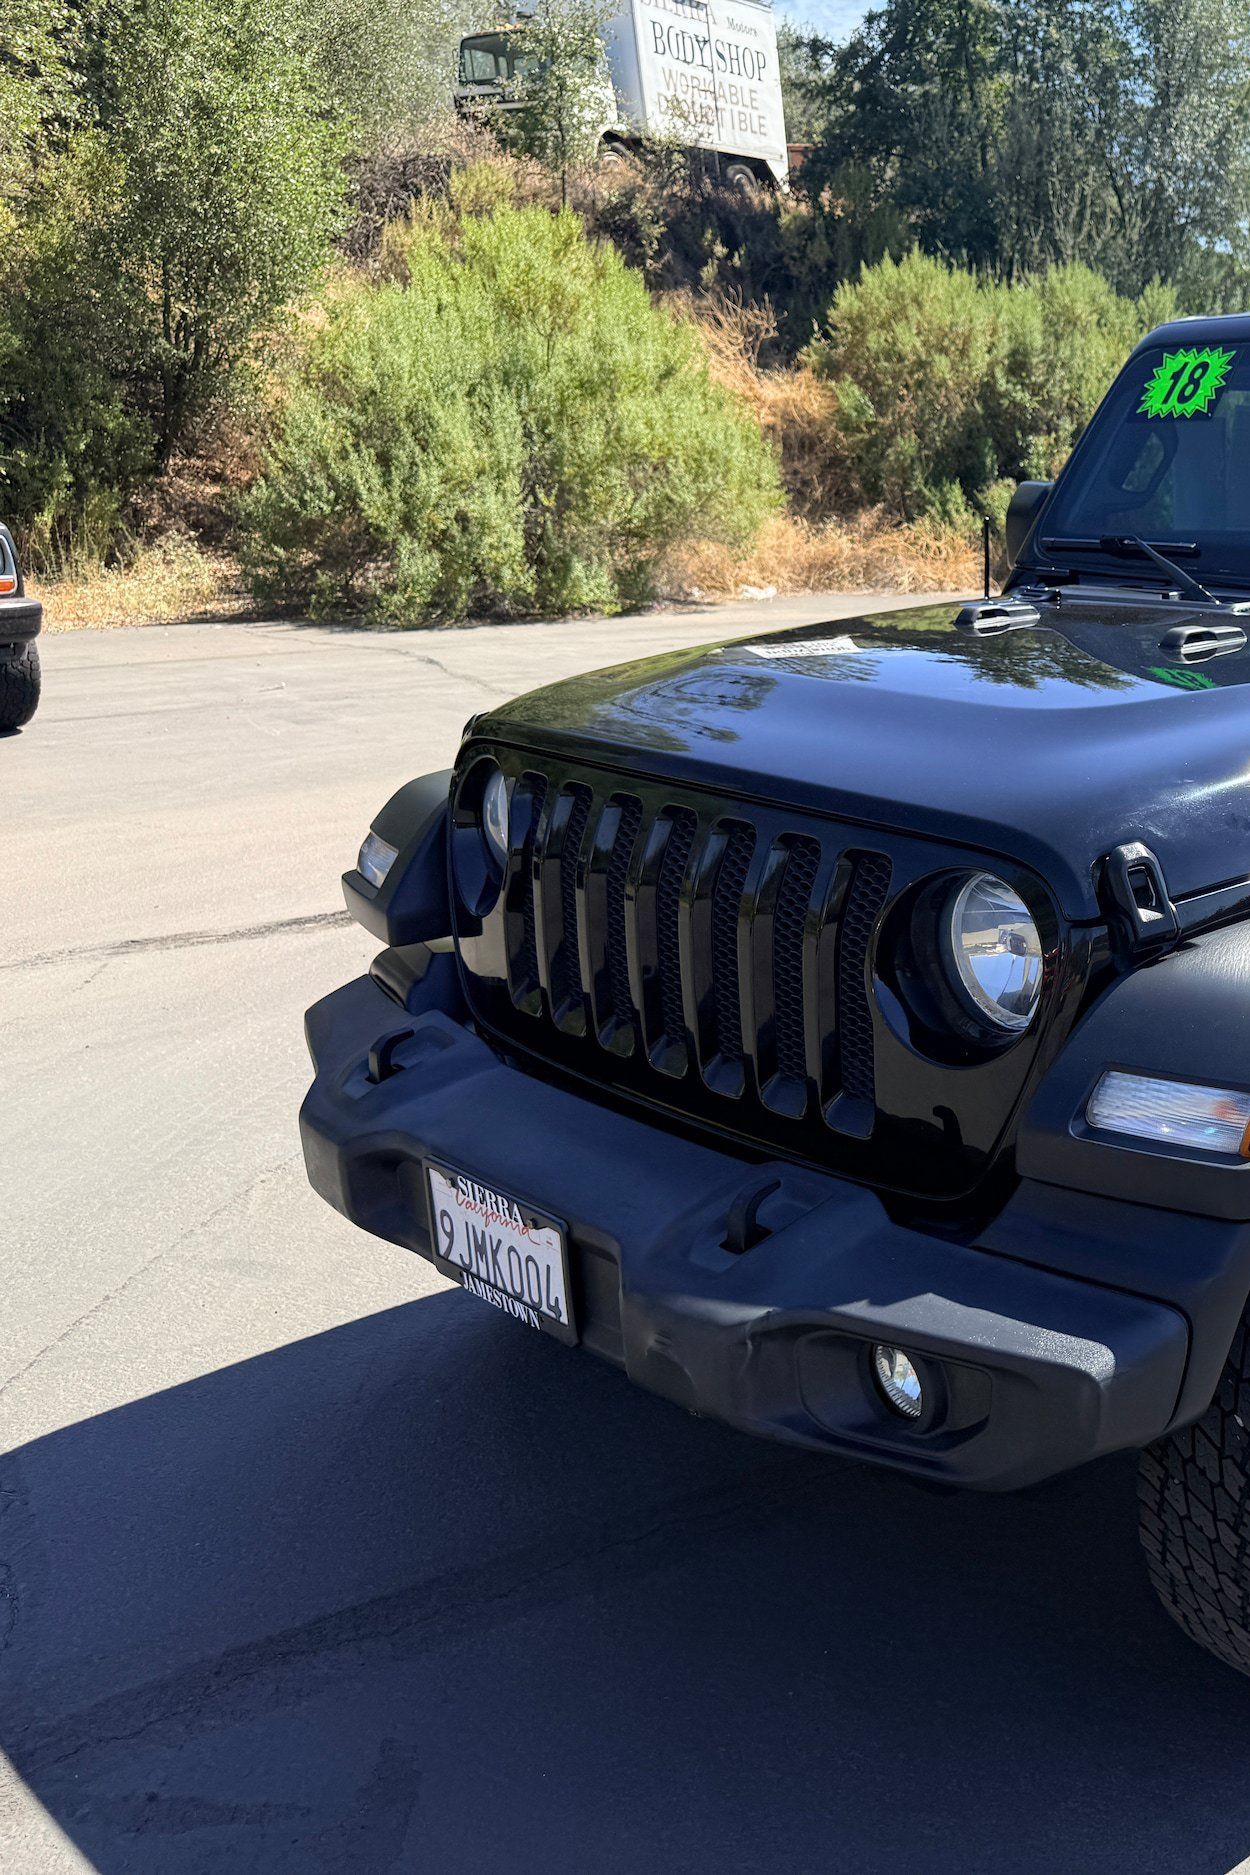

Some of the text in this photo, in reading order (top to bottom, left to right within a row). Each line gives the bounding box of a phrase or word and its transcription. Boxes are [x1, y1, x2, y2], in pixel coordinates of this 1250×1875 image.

[650, 20, 766, 81] BODY SHOP
[1160, 360, 1210, 405] 18
[456, 1175, 524, 1224] SIERRA
[440, 1209, 563, 1322] 9JMK004
[462, 1272, 541, 1331] JAMESTOWN
